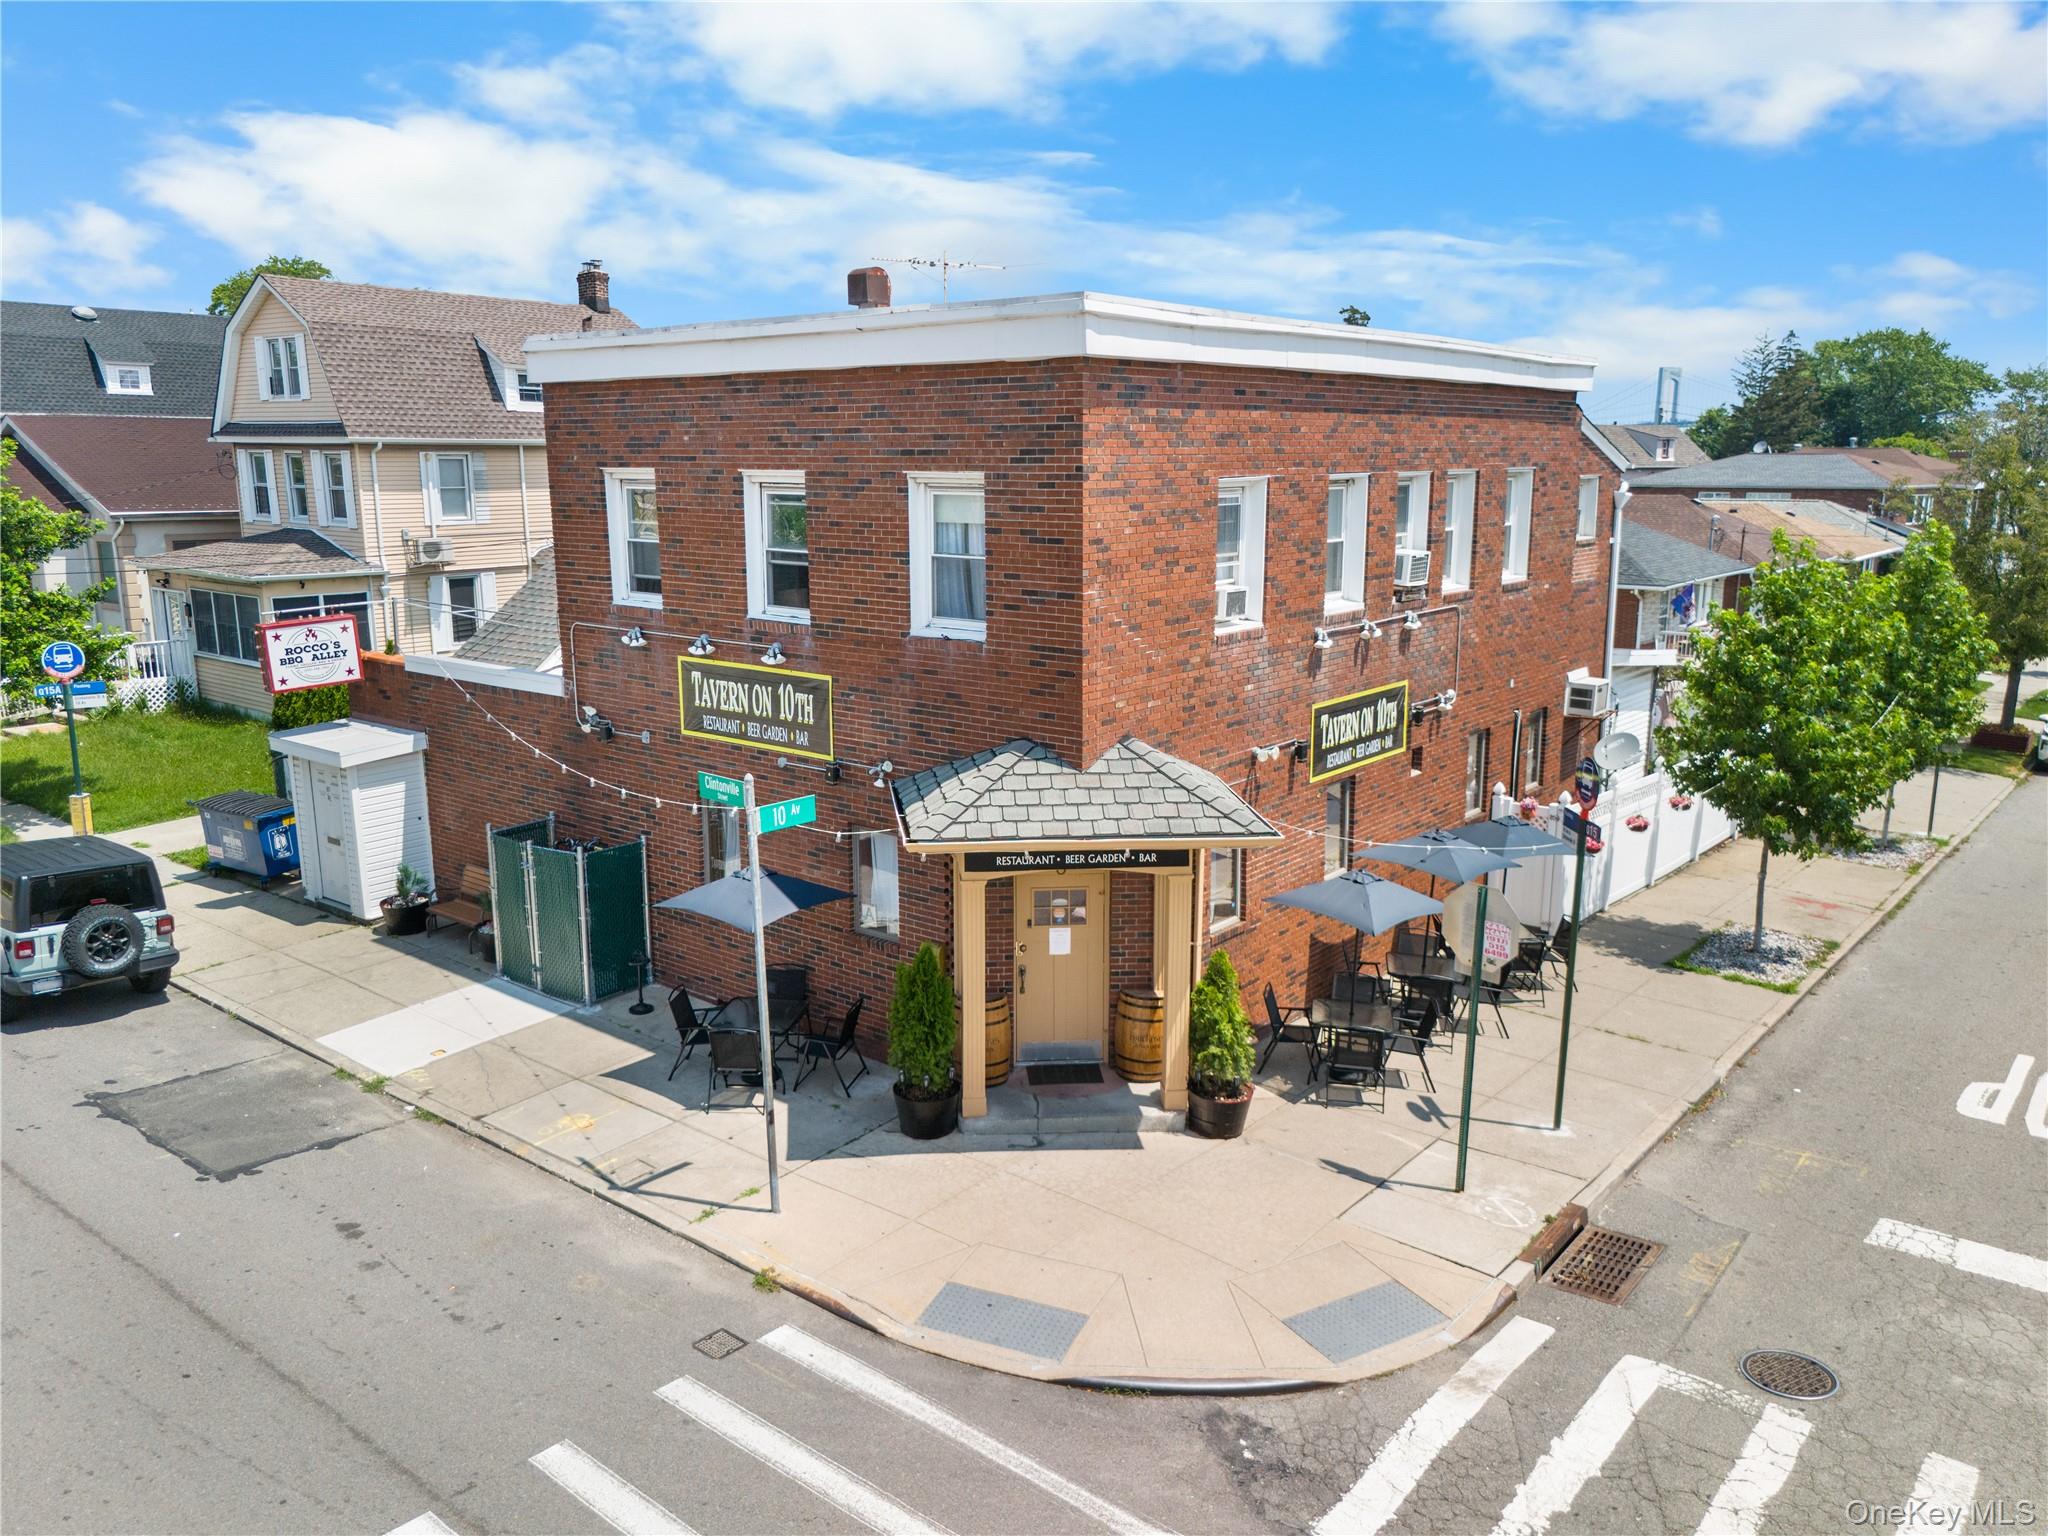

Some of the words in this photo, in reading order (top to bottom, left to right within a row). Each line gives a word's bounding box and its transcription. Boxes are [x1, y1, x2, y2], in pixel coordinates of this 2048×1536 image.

[280, 656, 304, 666] BBQ
[312, 650, 348, 661] ALLEY
[285, 641, 341, 656] ROCCO'S
[691, 671, 749, 715] TAVERN
[752, 684, 773, 719] ON
[778, 682, 814, 725] 10TH
[703, 715, 741, 735] RESTAURANT
[747, 722, 760, 738] BEER
[762, 725, 788, 743] GARDEN
[796, 731, 809, 746] BAR
[1320, 710, 1360, 749] TAVERN
[1360, 706, 1375, 738] ON
[1376, 698, 1398, 732] 10TH
[1326, 747, 1353, 768] RESTAURANT
[704, 776, 740, 796] Clintonville
[772, 805, 786, 827] 10
[791, 803, 800, 816] Av
[996, 855, 1055, 866] RESTAURANT
[1065, 854, 1085, 864] BEER
[1088, 853, 1127, 864] GARDEN
[1139, 853, 1157, 863] BAR
